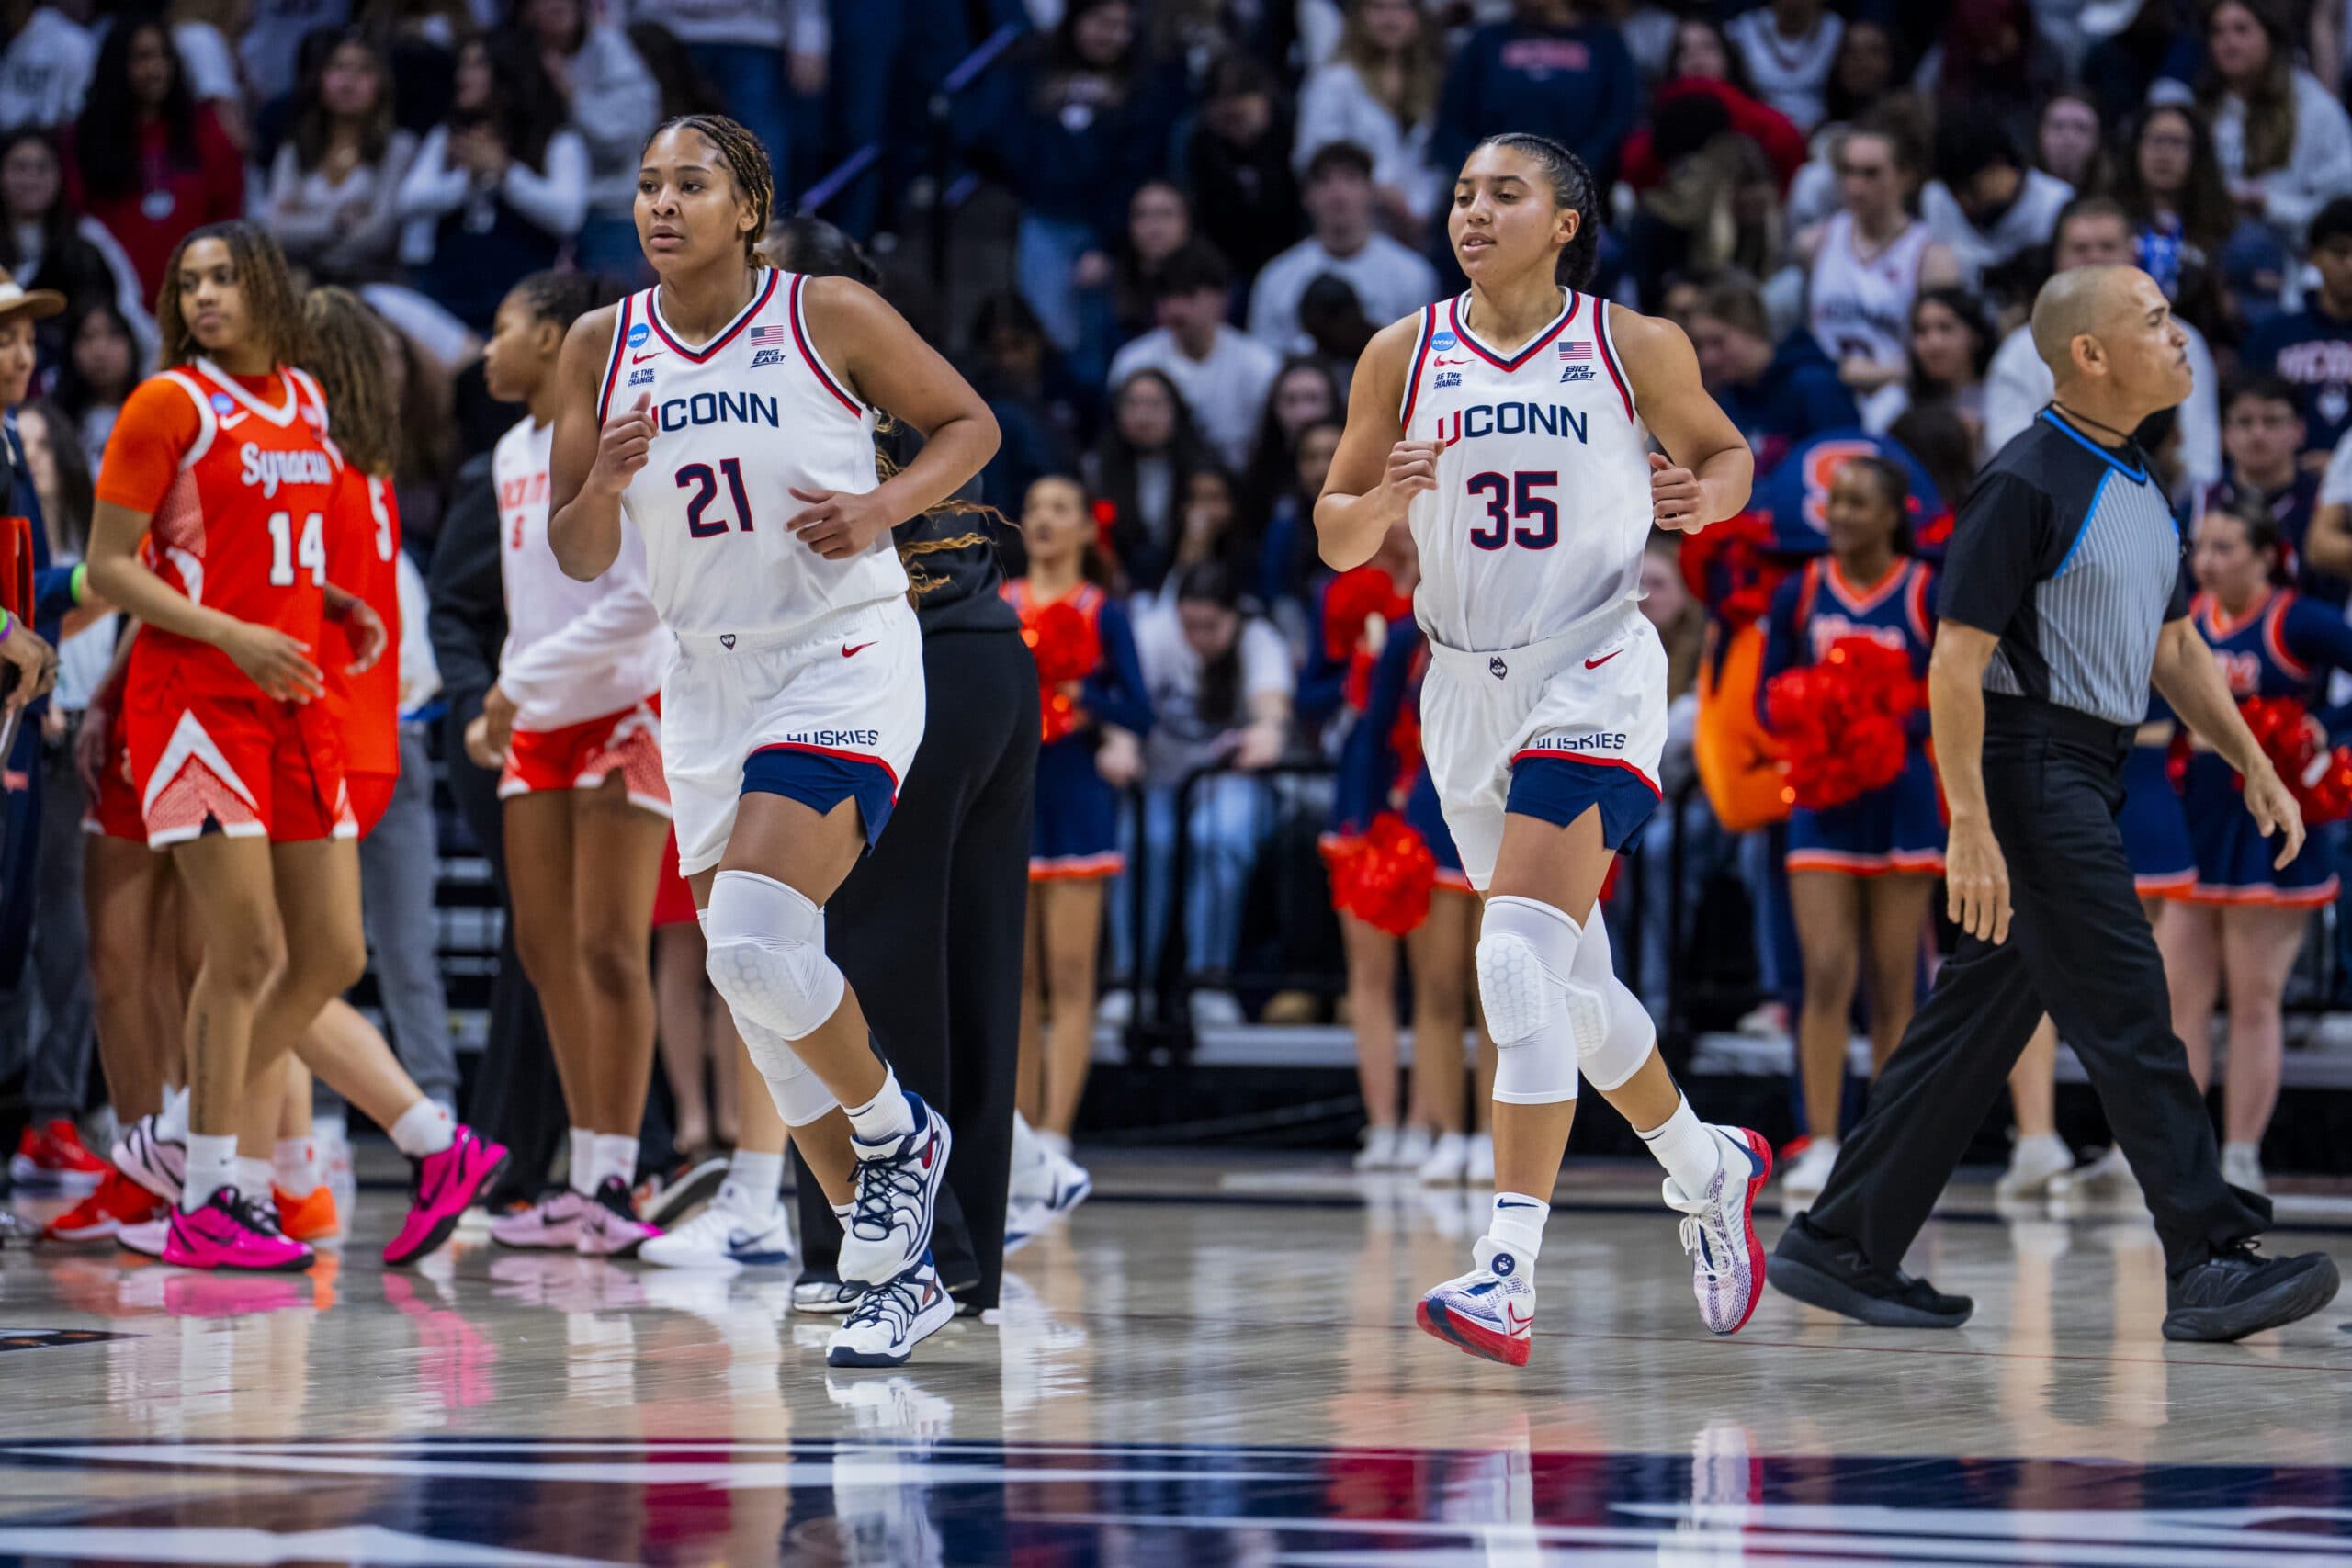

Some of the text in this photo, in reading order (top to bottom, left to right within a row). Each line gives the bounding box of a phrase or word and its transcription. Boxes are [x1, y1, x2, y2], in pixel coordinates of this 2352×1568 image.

[756, 349, 780, 357] BIG
[752, 355, 786, 364] EAST
[630, 368, 654, 379] BE THE
[1565, 365, 1590, 373] BIG
[628, 375, 655, 387] CHANGE
[1436, 372, 1446, 382] BE
[1433, 378, 1463, 389] CHANGE
[1437, 401, 1588, 448] UCONN
[674, 457, 754, 538] 21
[1466, 470, 1558, 551] 35
[268, 511, 326, 586] 14
